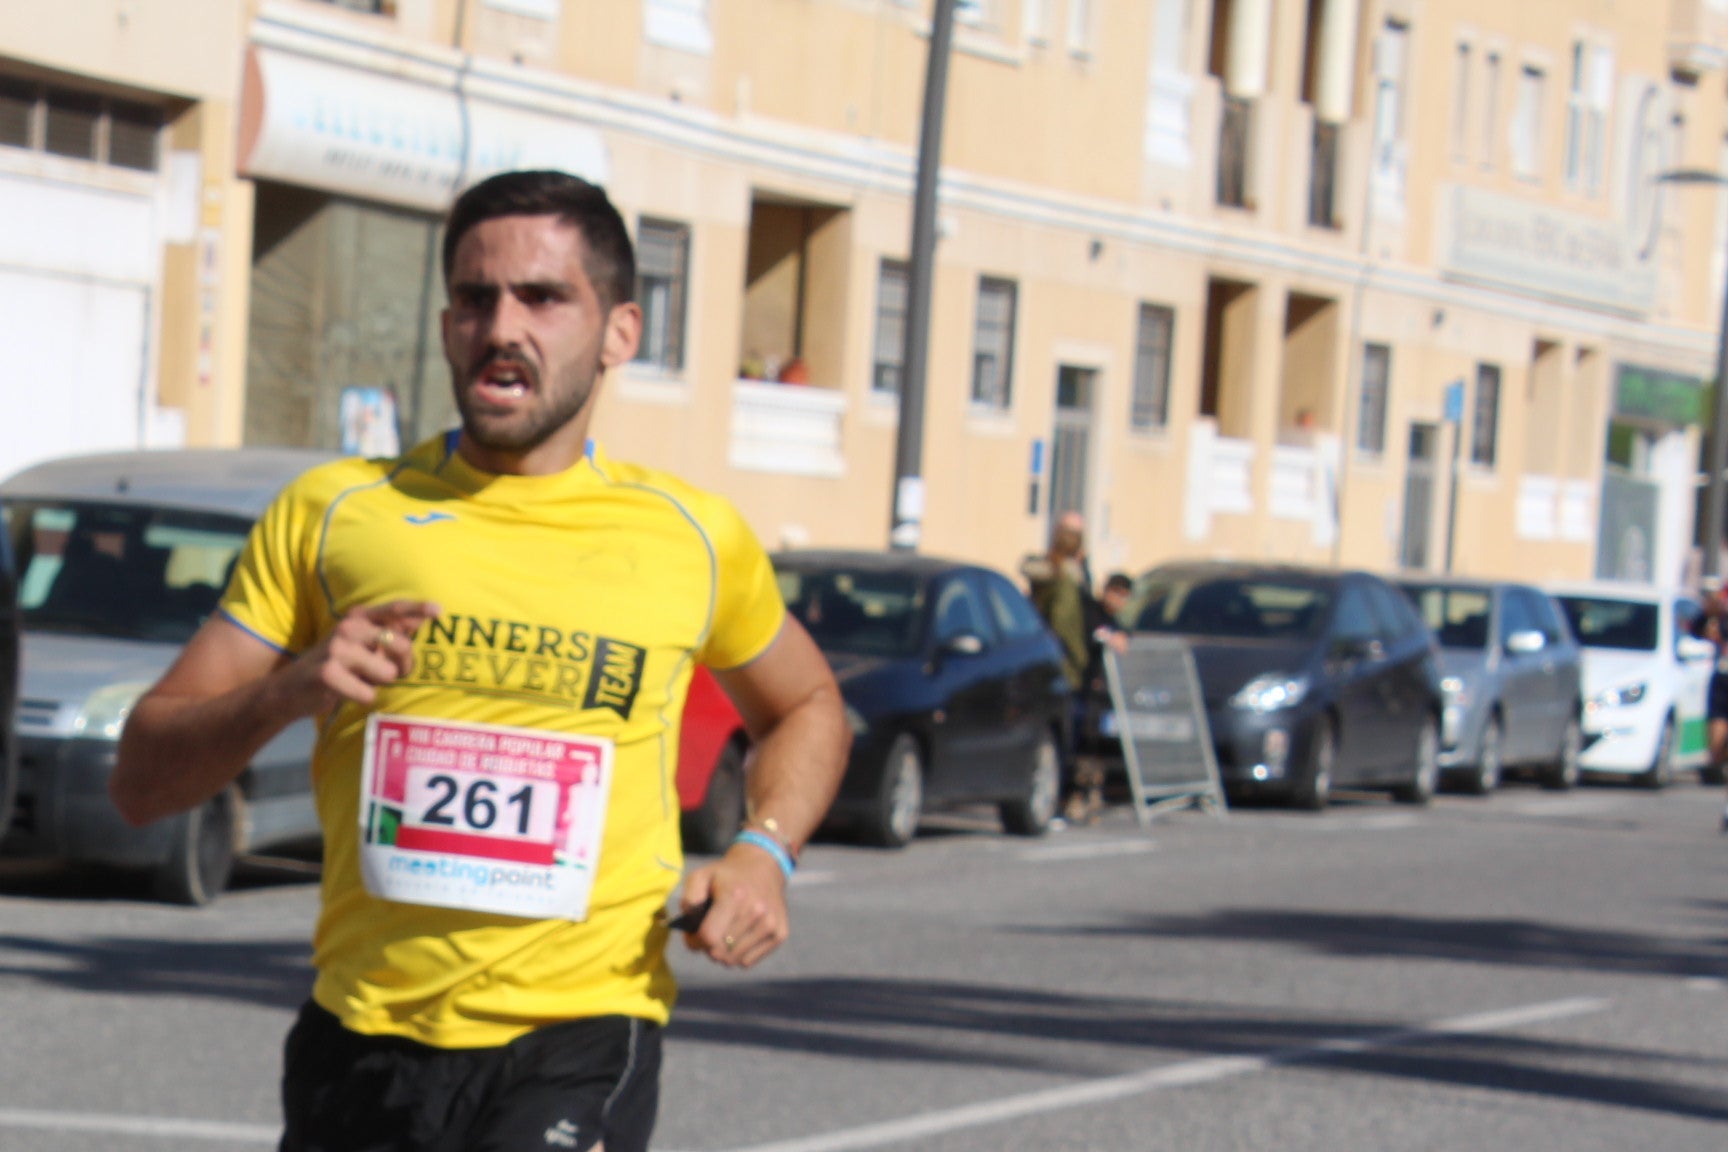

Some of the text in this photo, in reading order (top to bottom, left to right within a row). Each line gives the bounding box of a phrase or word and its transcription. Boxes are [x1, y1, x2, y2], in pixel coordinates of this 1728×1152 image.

[414, 614, 592, 663] NNERS
[409, 649, 582, 698] REVER
[594, 640, 640, 707] TEAM
[432, 728, 497, 752] CARRERA
[497, 735, 566, 762] POPULAR
[422, 773, 535, 836] 261
[389, 855, 556, 890] meetingpoint
